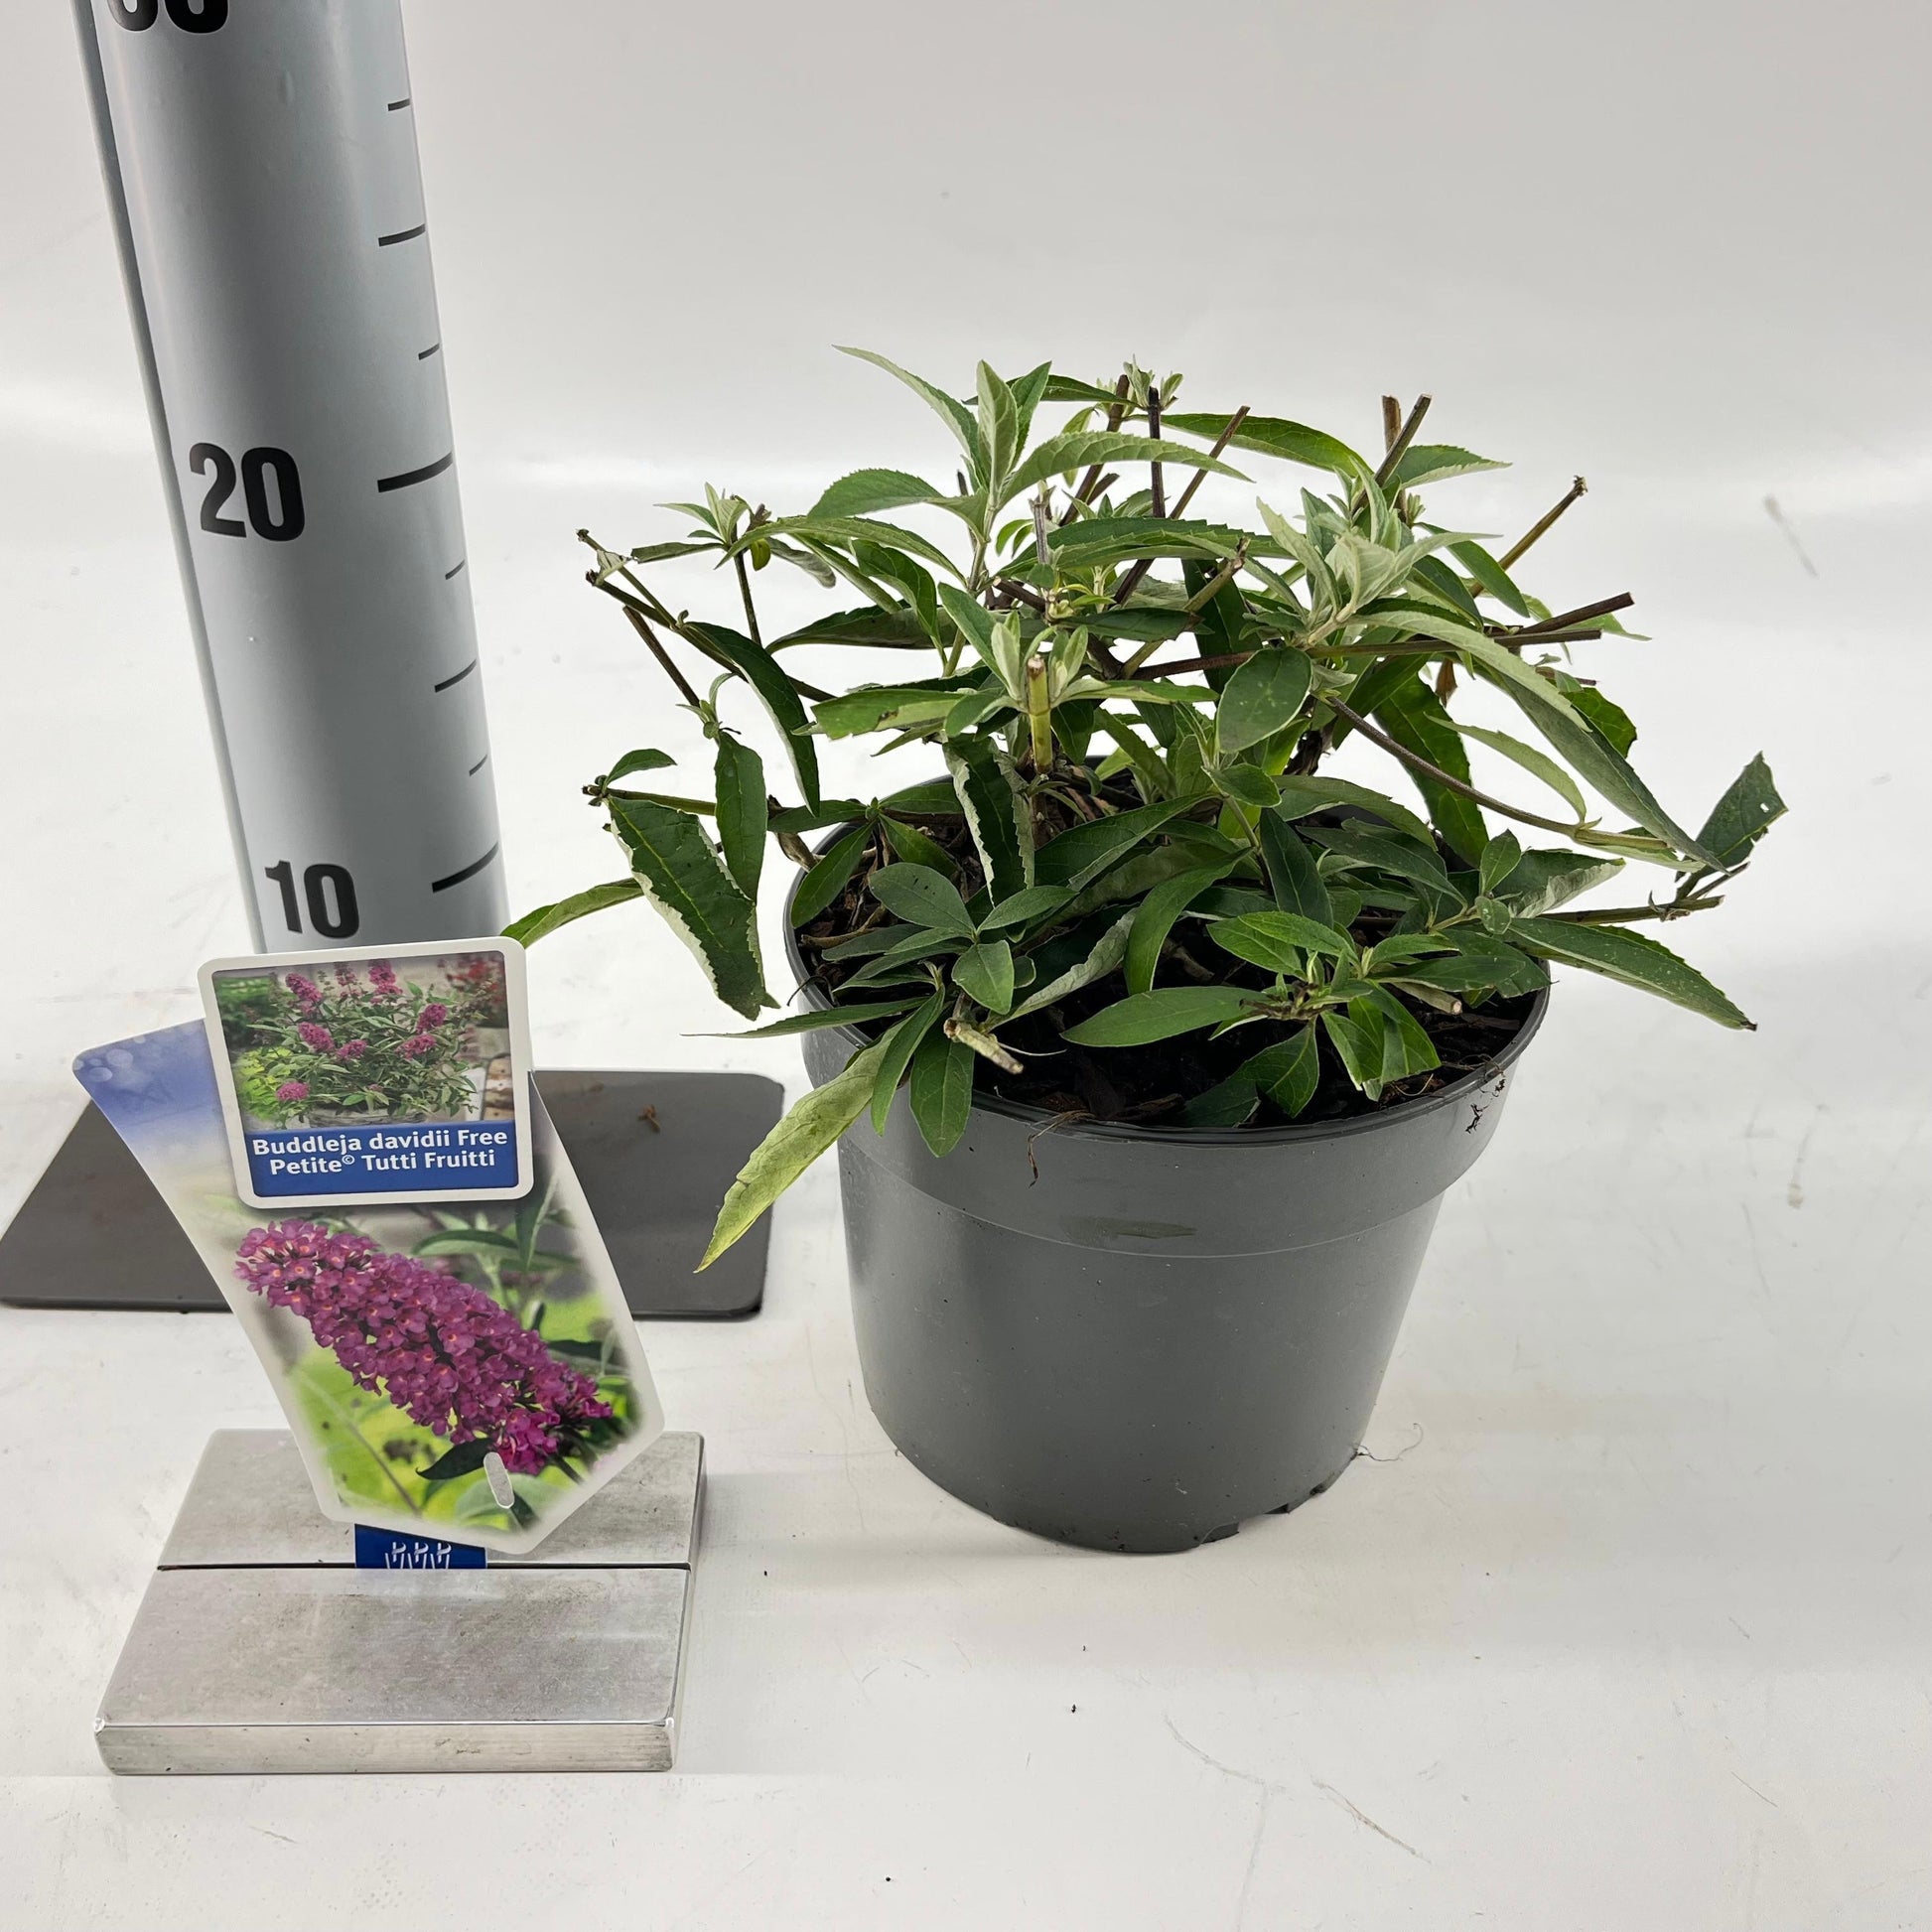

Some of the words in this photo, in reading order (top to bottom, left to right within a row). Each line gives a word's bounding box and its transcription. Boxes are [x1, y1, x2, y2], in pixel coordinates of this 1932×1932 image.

[189, 442, 306, 542] 20
[264, 860, 360, 939] 10
[252, 1134, 362, 1156] Buddleja
[368, 1130, 451, 1151] davidii
[458, 1129, 508, 1147] Free
[360, 1152, 417, 1172] Tutti
[424, 1149, 495, 1169] Fruitti
